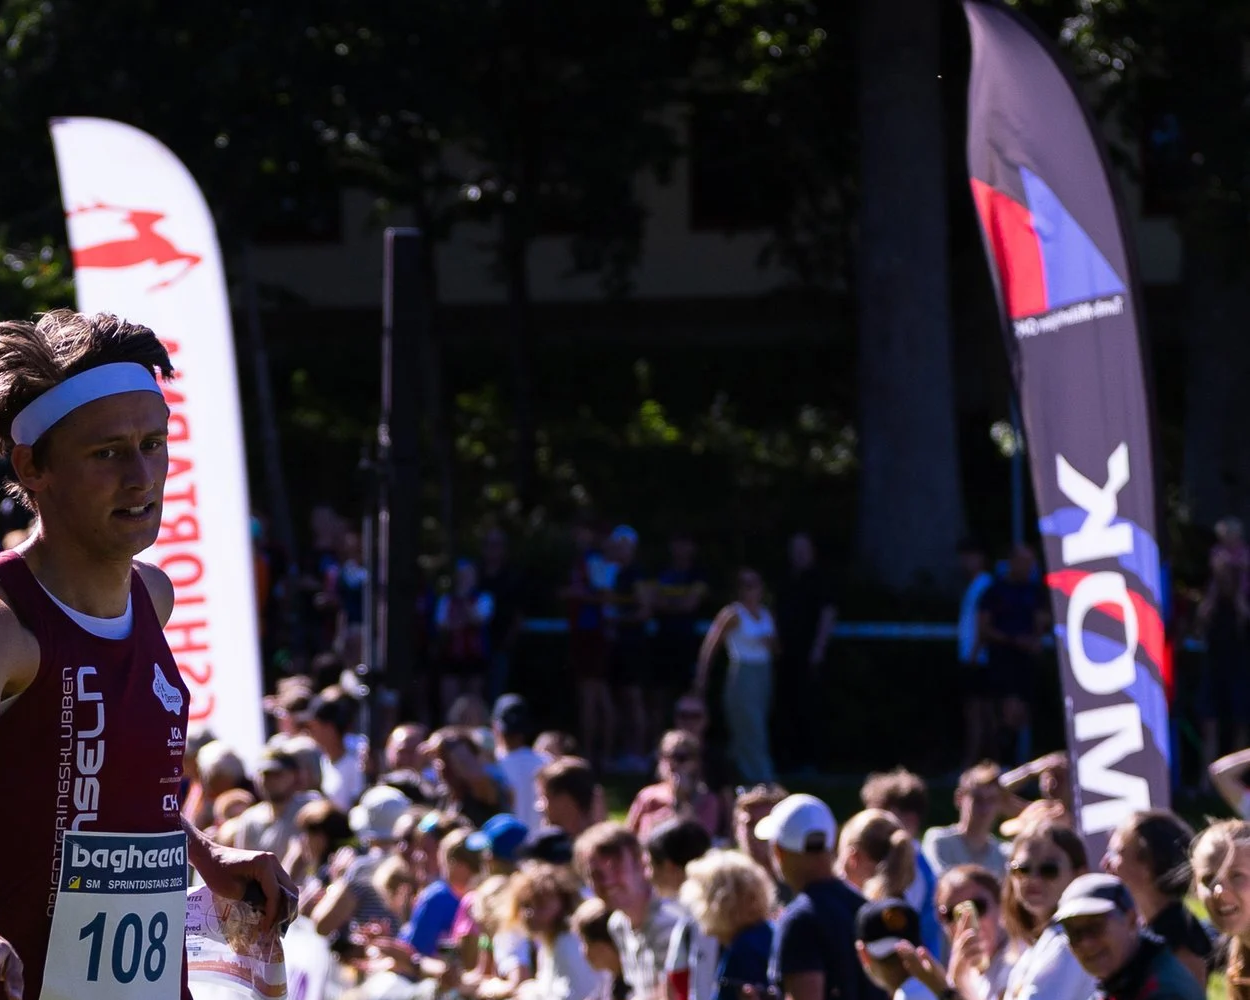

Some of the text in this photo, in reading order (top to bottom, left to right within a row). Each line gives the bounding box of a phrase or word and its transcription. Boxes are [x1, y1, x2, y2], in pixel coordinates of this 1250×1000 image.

[71, 844, 184, 873] bagheera
[86, 877, 183, 889] SM SPRINTDISTANS 2025
[79, 911, 168, 983] 108
